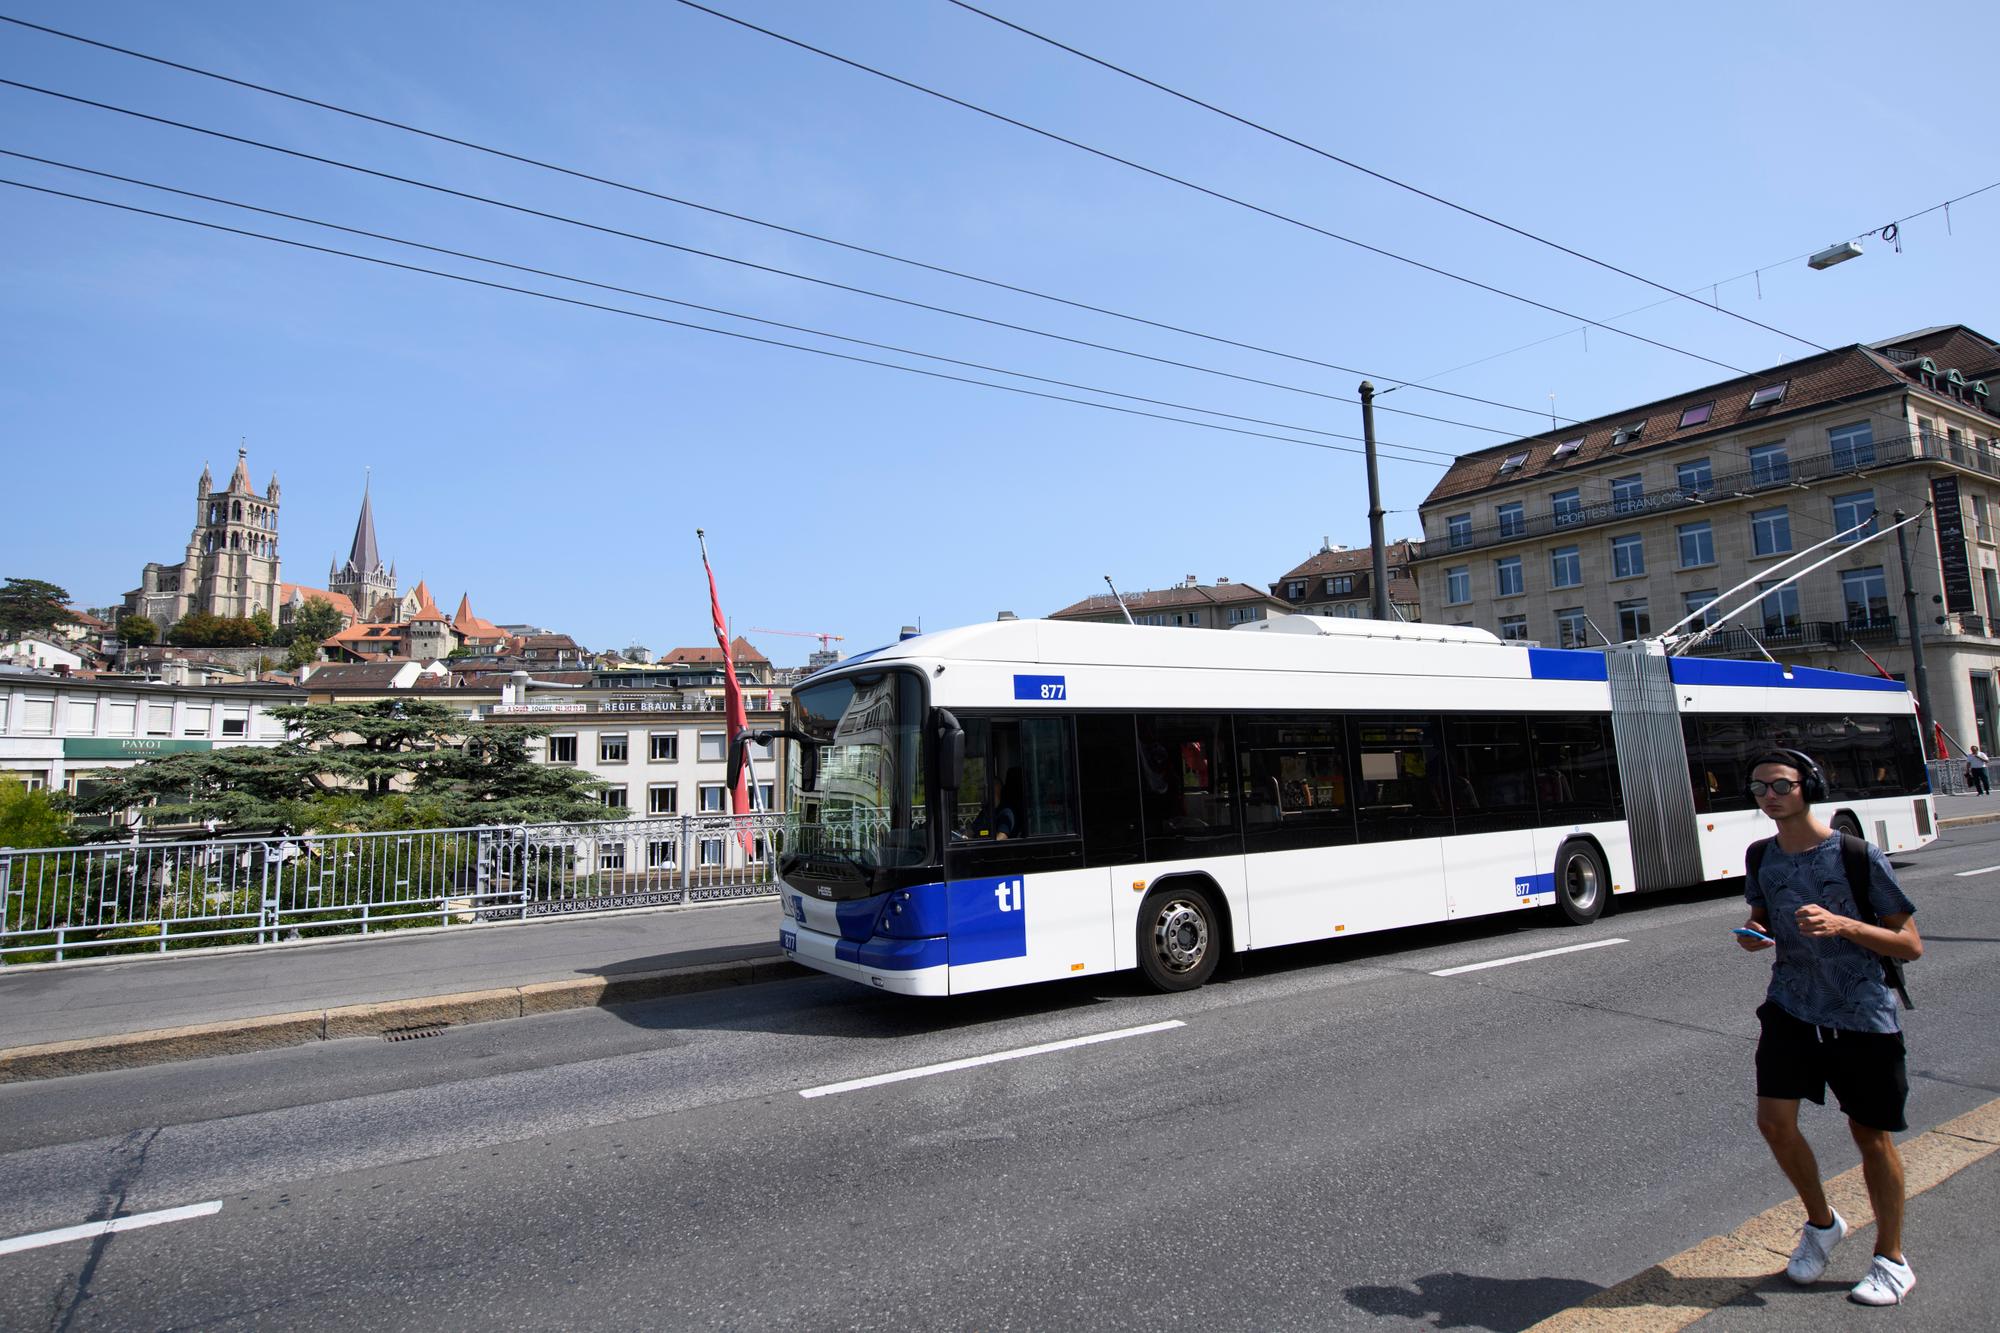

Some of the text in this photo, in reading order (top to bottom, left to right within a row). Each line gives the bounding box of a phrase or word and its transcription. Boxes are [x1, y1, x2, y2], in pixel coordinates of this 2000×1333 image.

[1561, 507, 1607, 523] PORTES
[1041, 684, 1064, 699] 877
[604, 702, 636, 712] REGIE
[640, 701, 677, 712] BRAUN
[122, 740, 162, 748] PAYOT
[994, 879, 1021, 912] tl
[1516, 882, 1530, 896] 877
